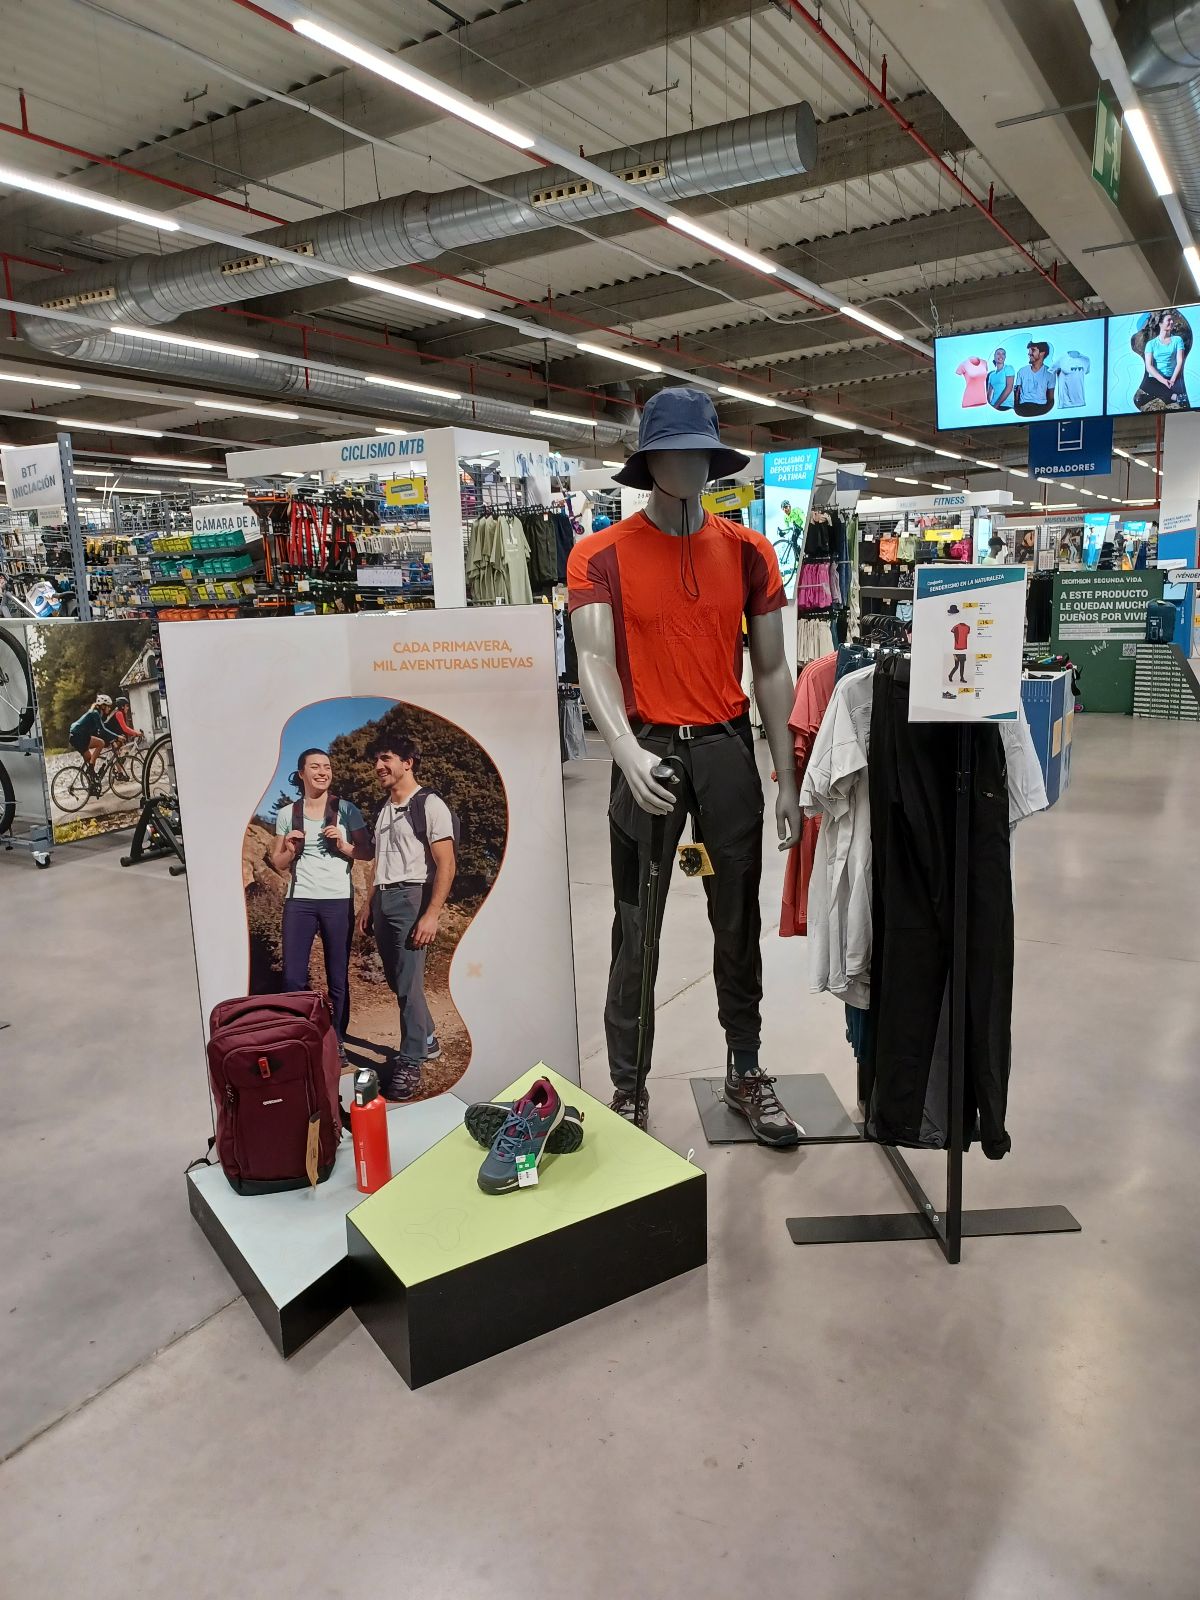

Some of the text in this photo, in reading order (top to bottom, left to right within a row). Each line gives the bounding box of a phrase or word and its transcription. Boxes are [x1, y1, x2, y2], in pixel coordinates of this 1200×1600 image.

[341, 438, 424, 461] CICLISMO MTB
[21, 463, 37, 479] BTT
[1034, 463, 1095, 475] PROBADORES
[11, 474, 56, 499] INICIACIÓN
[933, 496, 965, 506] FITNESS
[195, 516, 234, 531] CÁMARA
[237, 516, 248, 528] DE
[929, 582, 959, 592] SENDERISMO
[974, 574, 1005, 584] NATURALEZA
[1060, 589, 1148, 599] A ESTE PRODUCTO
[1060, 602, 1071, 610] LE
[1074, 601, 1113, 610] QUEDAN
[1059, 611, 1098, 621] DUEÑOS
[1101, 612, 1121, 621] POR
[393, 640, 513, 654] CADA PRIMAVERA,
[373, 656, 534, 672] MIL AVENTURAS NUEVAS
